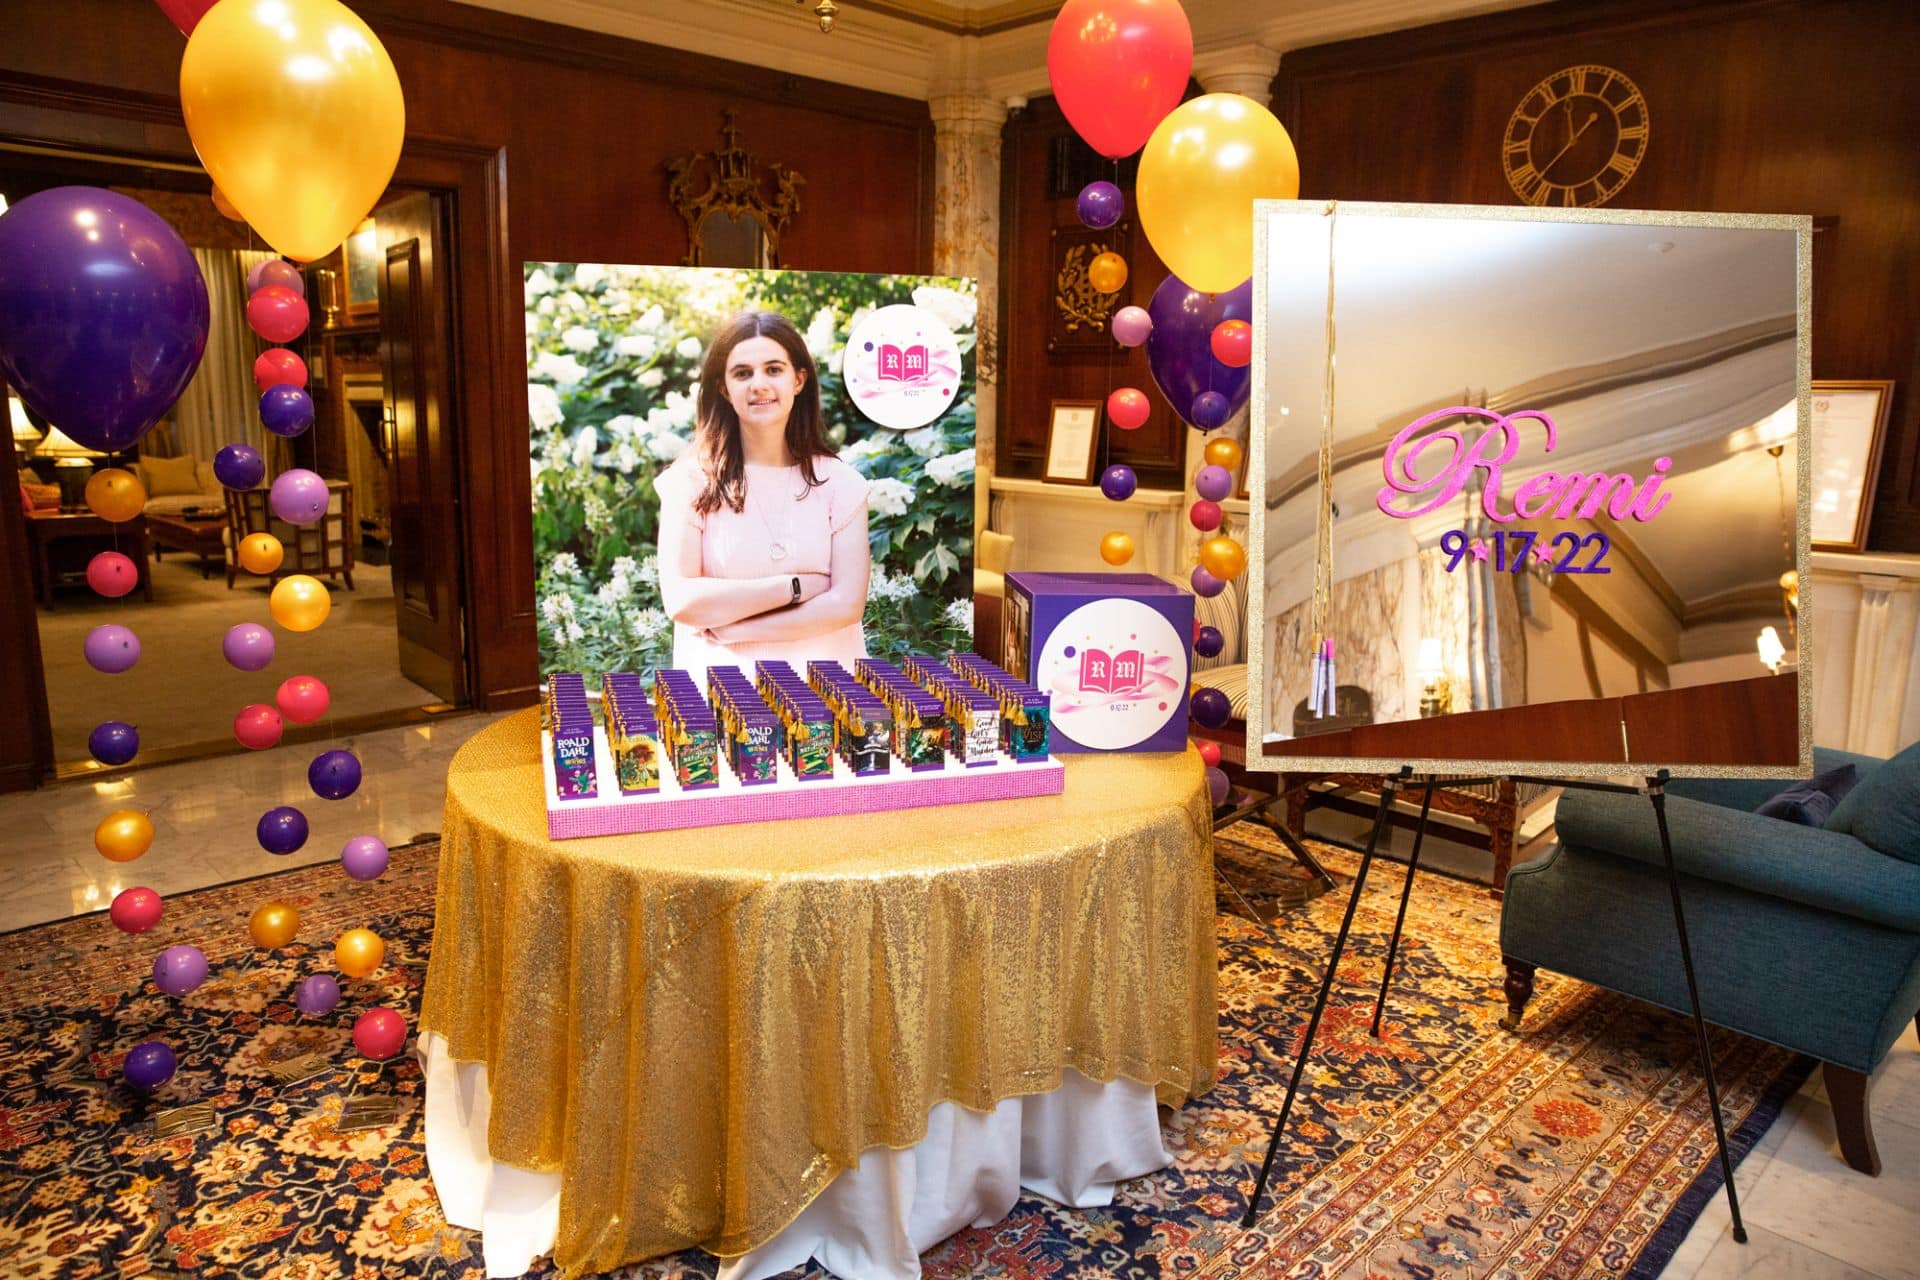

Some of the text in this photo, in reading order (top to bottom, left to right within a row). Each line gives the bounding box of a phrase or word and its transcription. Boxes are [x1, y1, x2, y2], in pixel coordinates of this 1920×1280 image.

[1376, 406, 1673, 524] Remi
[746, 726, 773, 737] OALD
[557, 737, 590, 749] ROALD
[560, 747, 589, 758] DAHL
